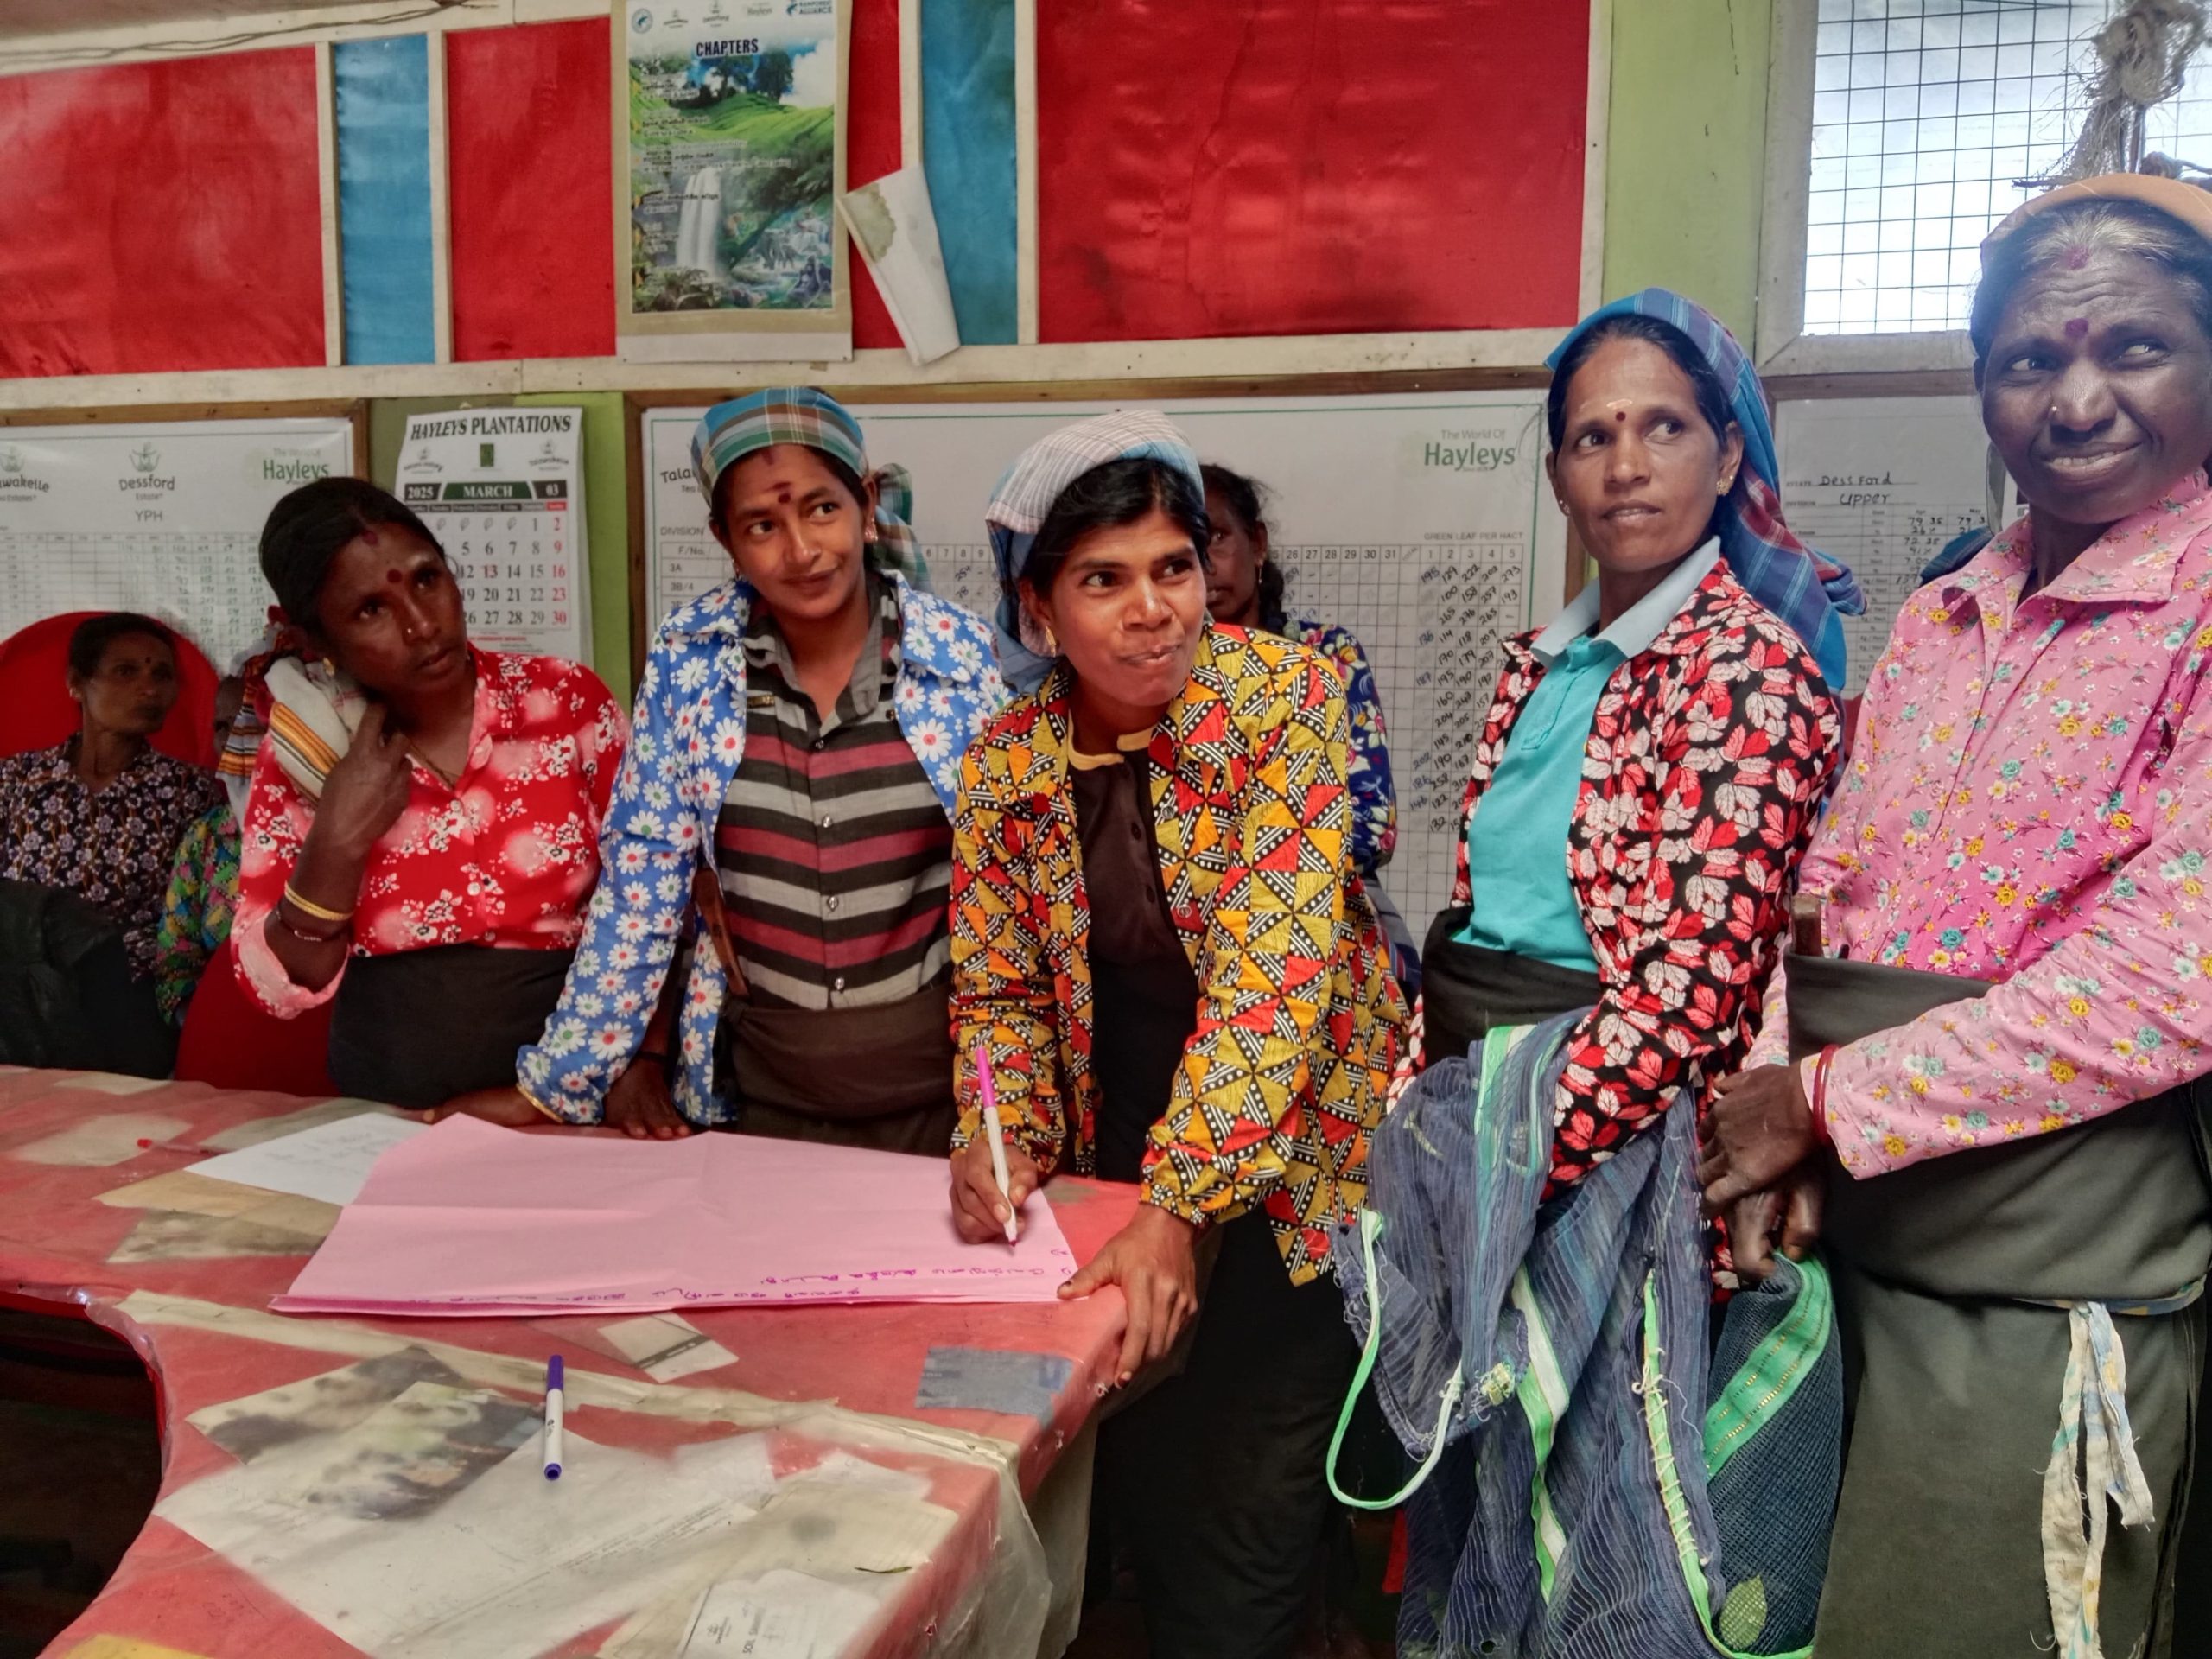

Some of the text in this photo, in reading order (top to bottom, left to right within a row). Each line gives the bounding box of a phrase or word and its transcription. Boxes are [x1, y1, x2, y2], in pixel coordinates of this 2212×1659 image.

[696, 38, 760, 57] CHAPTERS
[410, 416, 572, 441] HAYLEYS PLANTATIONS
[1424, 442, 1516, 472] Hayleys
[119, 474, 175, 491] Dessford
[407, 486, 434, 499] 2025
[463, 486, 513, 499] MARCH
[545, 485, 560, 497] 03
[1839, 493, 1891, 509] Upper
[135, 511, 163, 521] YPH
[533, 518, 538, 531] 1
[553, 518, 561, 531] 2
[660, 526, 705, 537] DIVISION
[1423, 531, 1453, 541] GREEN
[1456, 531, 1478, 540] LEAF
[1479, 531, 1497, 540] PER
[461, 541, 470, 556] 5
[485, 541, 494, 556] 6
[509, 541, 518, 556] 7
[531, 541, 540, 556] 8
[554, 541, 563, 556] 9
[943, 548, 950, 558] 7
[960, 548, 967, 558] 8
[977, 548, 984, 558] 9
[1286, 550, 1299, 560] 26
[1306, 550, 1318, 560] 27
[1325, 550, 1337, 560] 28
[1344, 550, 1357, 560] 29
[1364, 550, 1376, 560] 30
[1384, 550, 1396, 560] 31
[1427, 549, 1433, 559] 1
[1447, 549, 1454, 559] 2
[1467, 549, 1474, 559] 3
[1487, 549, 1494, 559] 4
[1509, 549, 1516, 559] 5
[460, 564, 474, 579] 12
[484, 564, 499, 579] 13
[507, 564, 521, 579] 14
[530, 564, 544, 579] 15
[552, 564, 566, 579] 16
[670, 563, 683, 572] 3A
[483, 588, 499, 602] 20
[506, 588, 521, 602] 21
[530, 588, 544, 602] 22
[552, 588, 567, 602] 23
[484, 610, 499, 626] 27
[507, 610, 523, 626] 28
[530, 610, 545, 626] 29
[551, 610, 567, 626] 30
